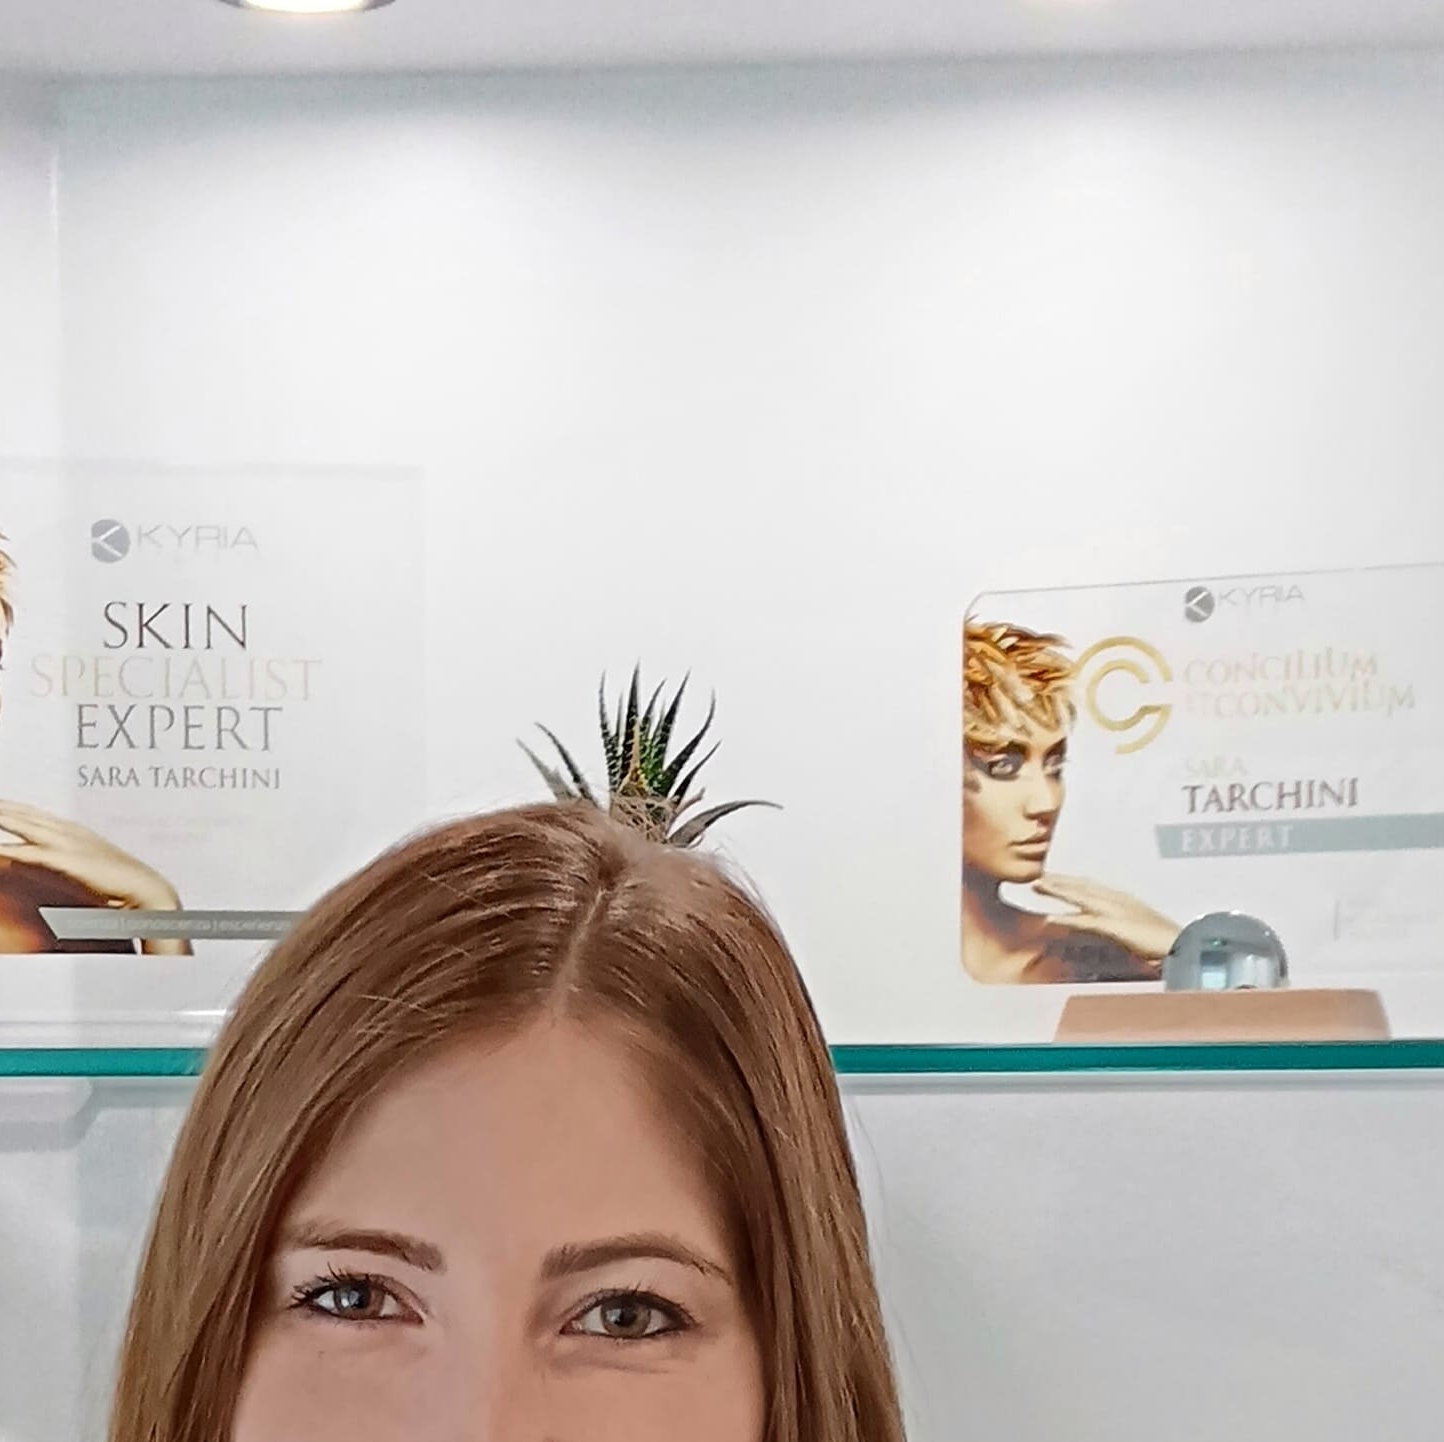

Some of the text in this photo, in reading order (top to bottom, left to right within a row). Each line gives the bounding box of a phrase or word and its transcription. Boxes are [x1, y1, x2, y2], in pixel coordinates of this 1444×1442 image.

[137, 523, 260, 551] KYRIA
[102, 601, 249, 651] SKIN
[29, 655, 323, 703] SPECIALIST
[1184, 647, 1378, 687] CONCILIUM
[75, 703, 283, 753] EXPERT
[77, 765, 281, 791] SARA TARCHINI
[1181, 777, 1359, 814] TARCHINI
[1182, 825, 1293, 852] EXPERT
